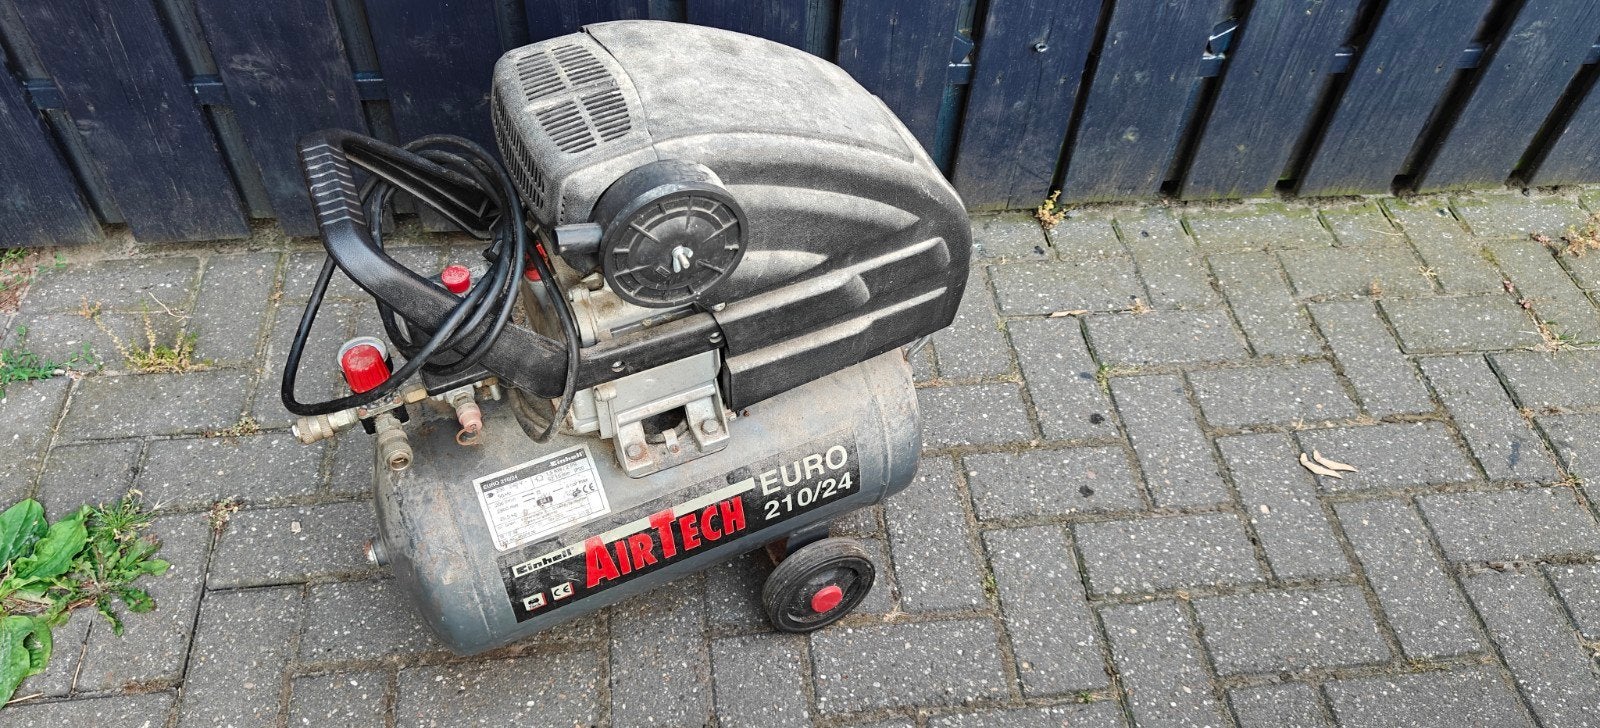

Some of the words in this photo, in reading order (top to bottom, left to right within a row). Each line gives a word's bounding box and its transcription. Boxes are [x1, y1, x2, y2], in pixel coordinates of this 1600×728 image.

[550, 452, 583, 467] Einhell
[760, 445, 848, 496] EURO
[483, 481, 500, 490] EURO
[764, 472, 852, 520] 210/24
[516, 548, 572, 575] Einhell
